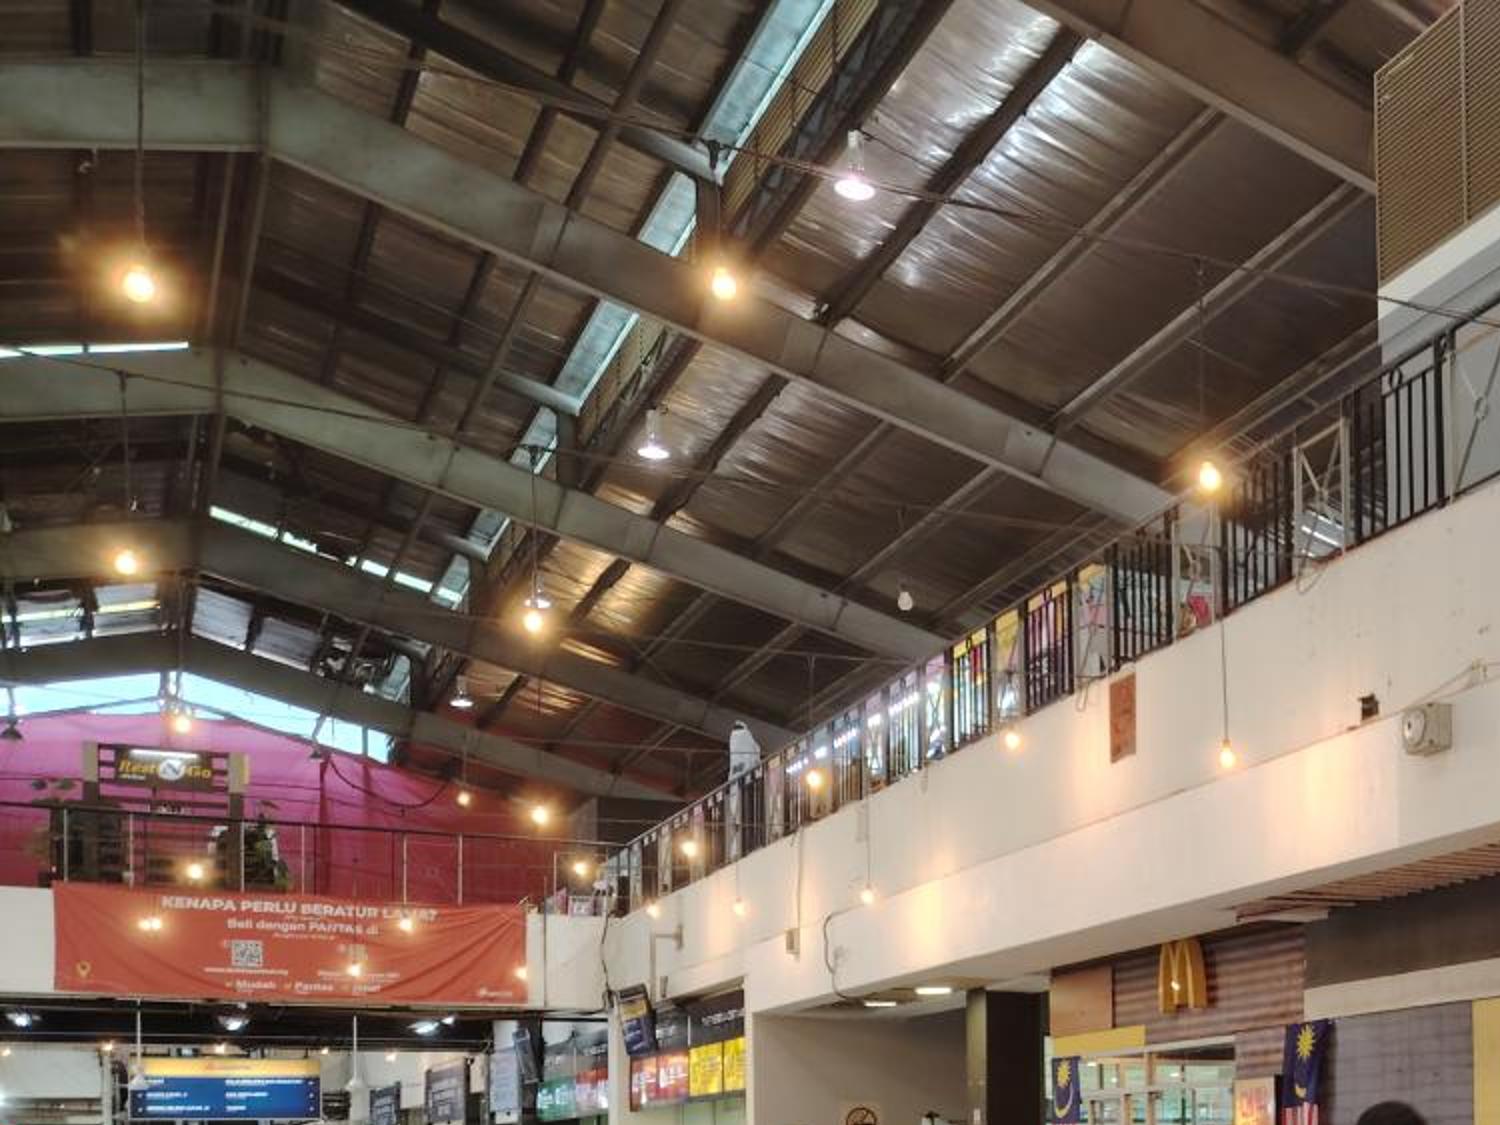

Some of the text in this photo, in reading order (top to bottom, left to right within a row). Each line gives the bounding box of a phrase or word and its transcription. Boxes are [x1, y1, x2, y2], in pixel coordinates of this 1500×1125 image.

[161, 895, 237, 911] KENAPA
[240, 900, 298, 913] PERLU
[301, 902, 379, 919] BERATUR
[255, 919, 306, 933] dengan
